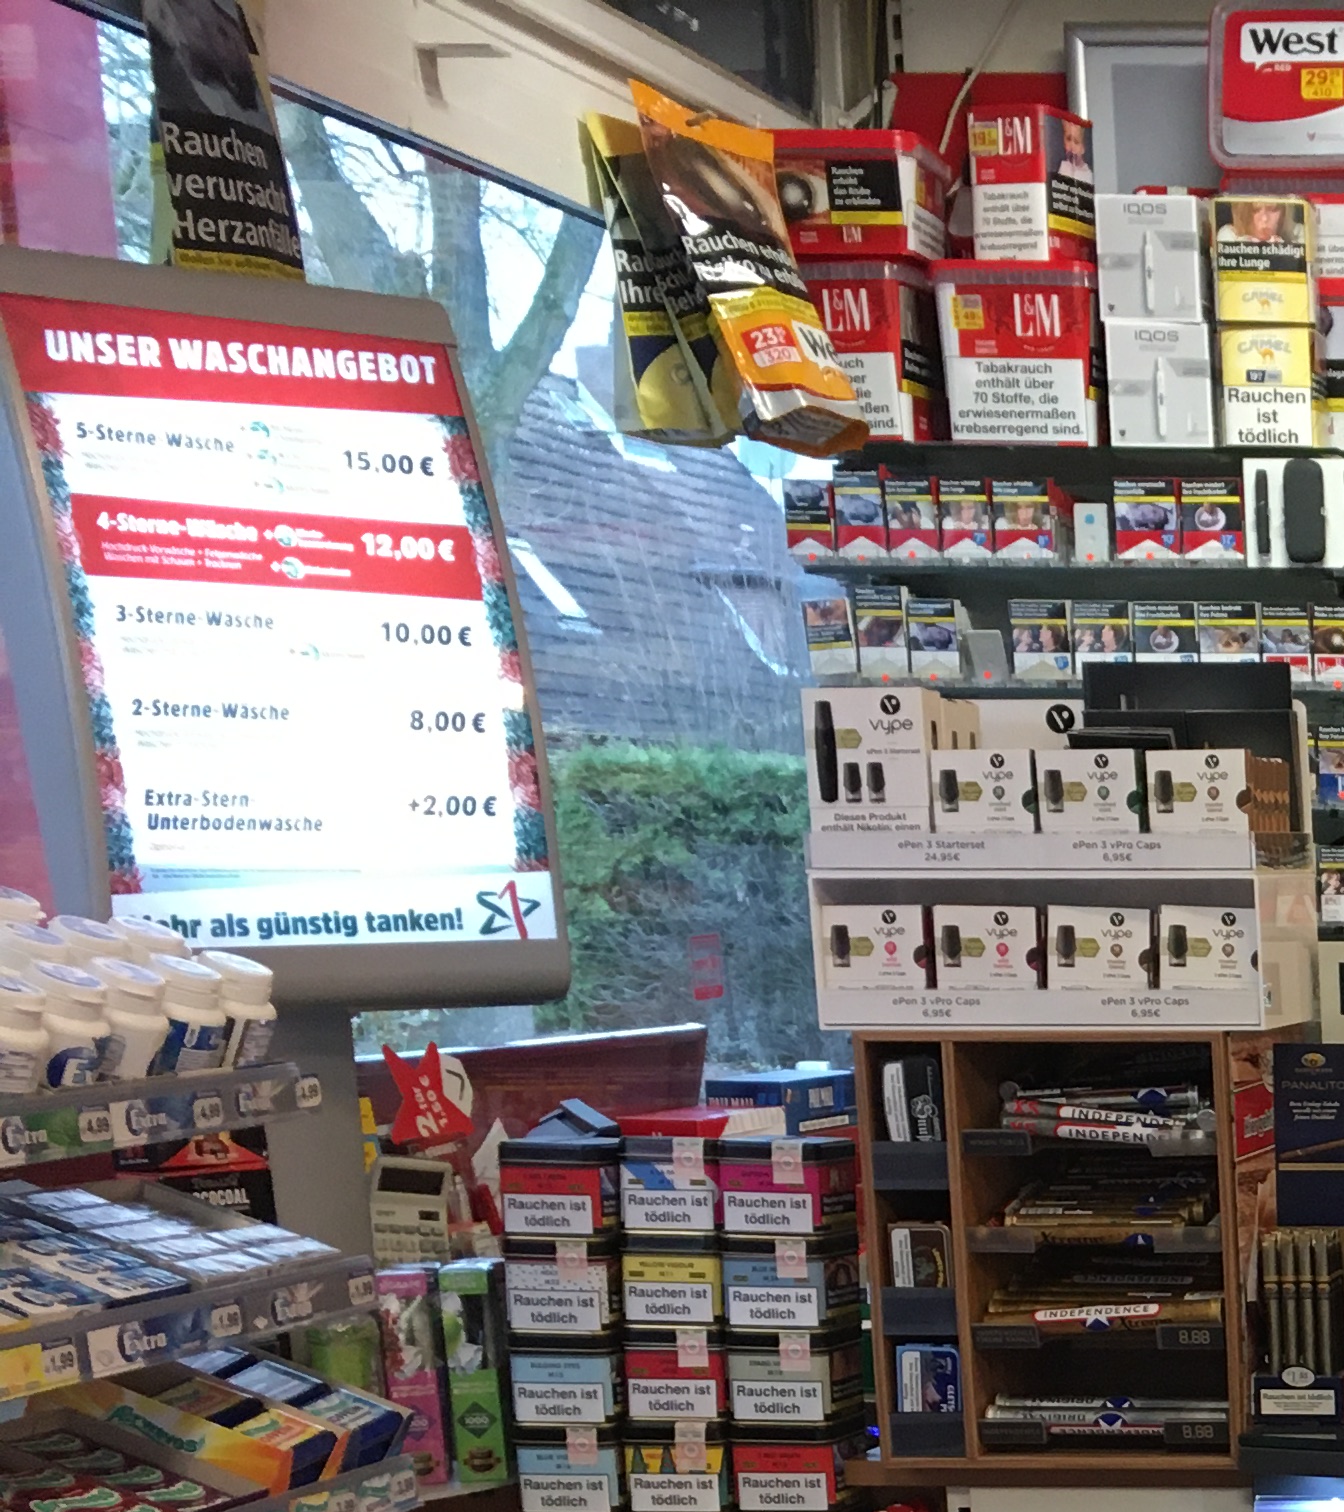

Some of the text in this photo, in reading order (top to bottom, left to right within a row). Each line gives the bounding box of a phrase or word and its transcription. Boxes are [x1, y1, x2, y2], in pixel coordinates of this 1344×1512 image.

[1248, 28, 1340, 54] West
[161, 121, 268, 170] Rauchen
[168, 171, 288, 218] verursacht
[1218, 243, 1305, 257] Rauchen schädigt
[1218, 257, 1270, 269] Ihre Lunge
[1014, 293, 1061, 338] L&M
[44, 329, 437, 384] UNSER WASCHANGEBOT
[976, 361, 1053, 375] Tabakrauch
[976, 376, 1054, 390] enthält über
[973, 392, 1058, 406] 70 Stoffe, die
[1228, 387, 1306, 404] Rauchen
[958, 408, 1076, 420] erwiesenermaßen
[1257, 408, 1279, 424] ist
[954, 423, 1084, 436] krebserregend sind.
[1237, 427, 1299, 444] tödlich
[343, 450, 414, 475] 15,00
[420, 456, 434, 475] €
[360, 532, 434, 560] 12,00
[438, 539, 456, 561] €
[381, 622, 452, 646] 10,00
[458, 626, 472, 646] €
[410, 710, 467, 733] 8,00
[471, 713, 486, 732] €
[869, 717, 913, 737] vype
[408, 796, 477, 817] +2,00
[482, 797, 498, 816] €
[211, 911, 250, 938] als
[257, 910, 358, 944] günstig
[365, 907, 463, 933] tanken!
[1044, 1304, 1150, 1318] INDEPENDENCE
[633, 1477, 715, 1493] Rauchen ist
[649, 1494, 697, 1509] tödlich
